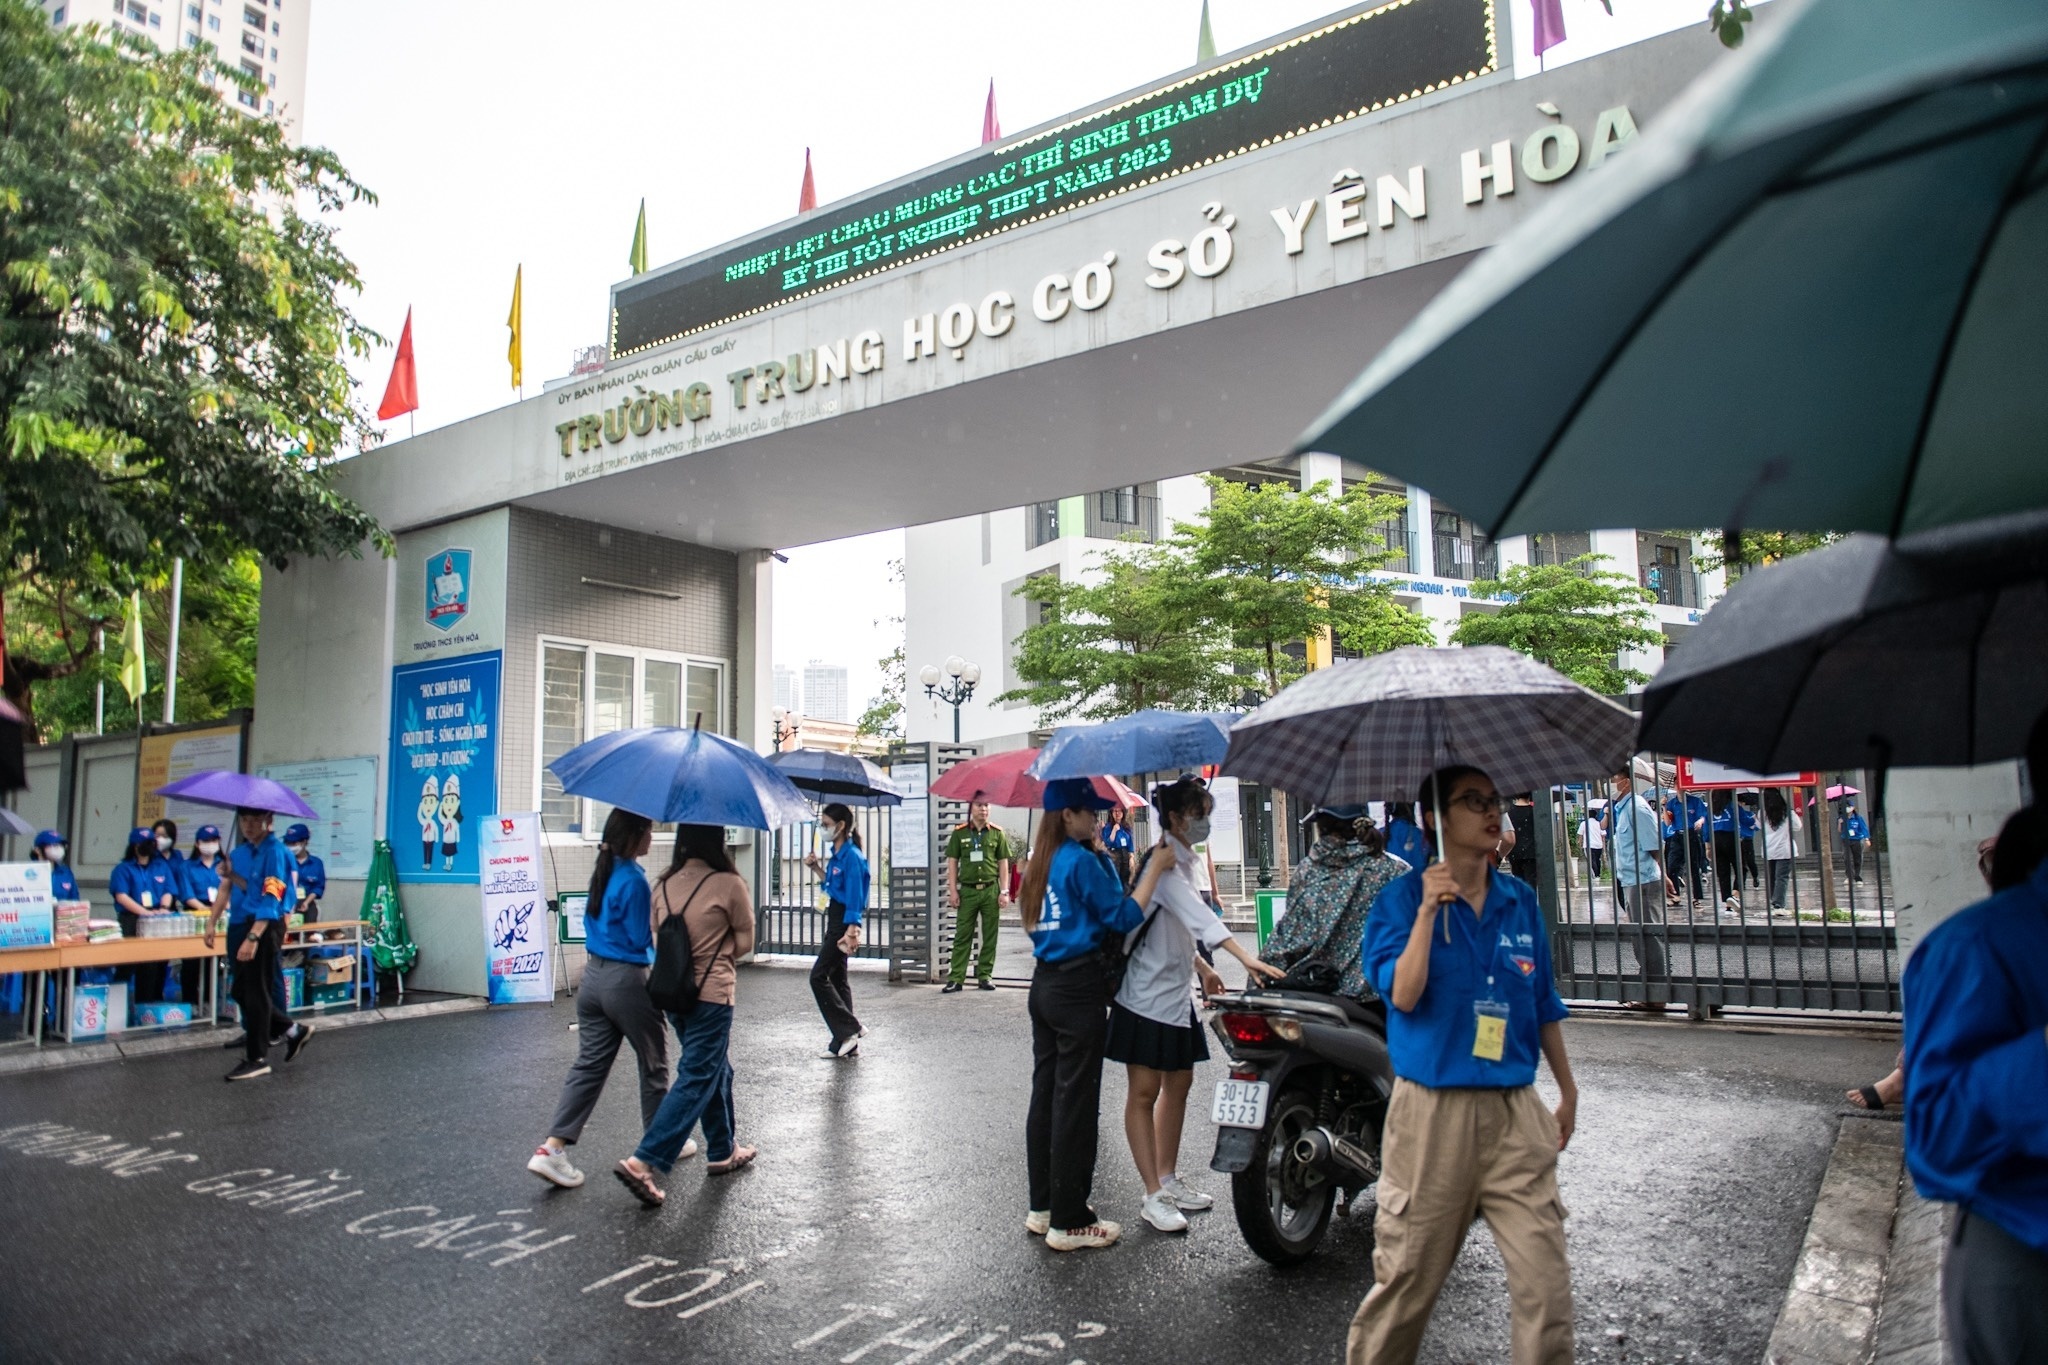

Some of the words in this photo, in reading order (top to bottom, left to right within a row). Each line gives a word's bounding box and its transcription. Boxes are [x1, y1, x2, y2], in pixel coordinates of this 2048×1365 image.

[1069, 119, 1131, 161] SINH
[1135, 88, 1218, 137] THAM
[1053, 157, 1114, 199] NĂM
[1119, 137, 1173, 177] 2023
[555, 383, 712, 458] TRƯỜNG
[727, 329, 884, 410] TRUNG
[903, 290, 1016, 362] HỌC
[1032, 250, 1119, 324] CƠ
[1144, 200, 1238, 290] SỞ
[1270, 165, 1428, 257] YÊN
[1459, 99, 1641, 207] HÒA
[574, 385, 595, 401] BAN
[597, 374, 625, 393] NHÂN
[627, 367, 649, 384] DÂN
[651, 359, 682, 374] QUẬN
[1410, 581, 1444, 595] NGOAN
[413, 640, 436, 651] TRƯỜNG
[437, 637, 452, 647] THCS
[453, 634, 464, 643] YÊN
[465, 631, 479, 642] HÒA
[434, 681, 448, 696] SINH
[448, 677, 458, 695] YÊN
[425, 706, 438, 722] HỌC
[439, 723, 455, 743] SỐNG
[489, 857, 511, 866] CHƯƠNG
[494, 870, 510, 883] TIẾP
[510, 869, 528, 882] SỨC
[484, 882, 503, 895] MÙA
[503, 882, 516, 893] THI
[517, 881, 539, 892] 2023
[513, 953, 542, 973] 2023
[1217, 1103, 1257, 1124] 5523
[345, 1204, 577, 1268] CÁCH
